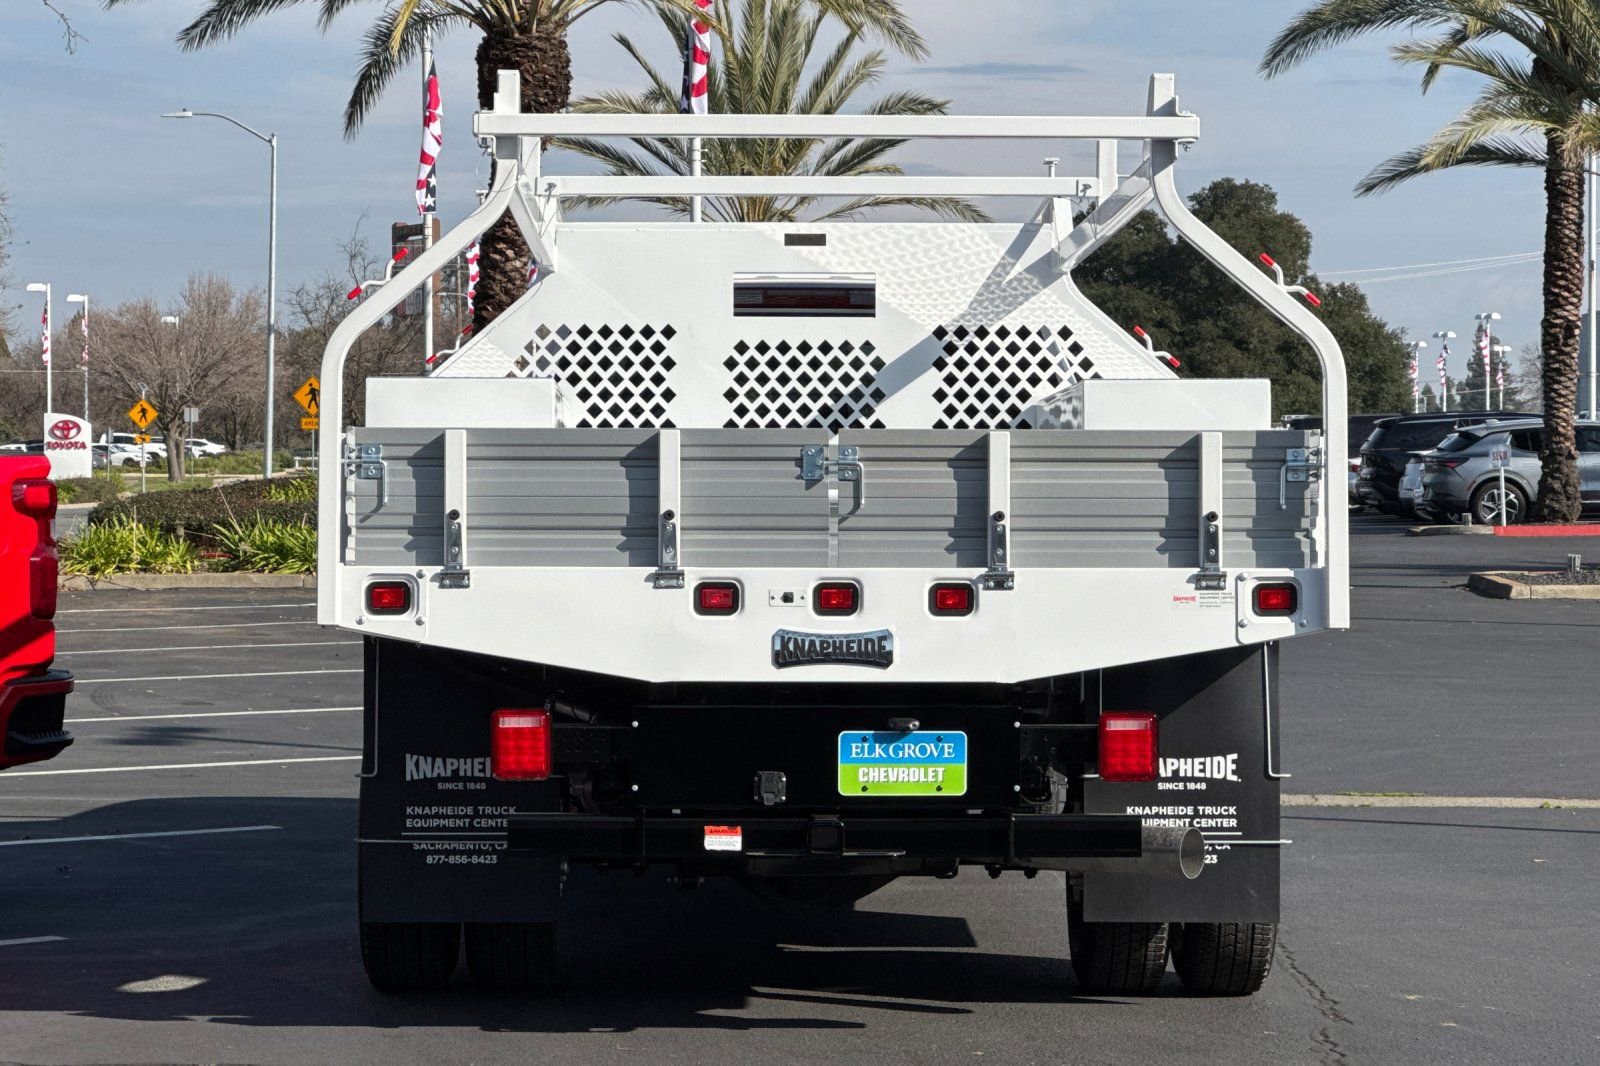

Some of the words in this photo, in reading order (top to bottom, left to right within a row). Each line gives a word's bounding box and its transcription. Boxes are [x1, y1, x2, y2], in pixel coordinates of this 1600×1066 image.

[303, 420, 320, 428] AHEA
[47, 441, 87, 450] TOYOTA
[779, 635, 889, 664] KNAPHEIDE
[850, 743, 887, 758] ELK
[889, 743, 956, 758] GROVE
[405, 753, 491, 781] KNAPHEI
[1159, 753, 1238, 782] APHEIDE
[858, 767, 945, 783] CHEVROLET
[437, 782, 464, 790] SINCE
[466, 782, 486, 790] 1848
[1157, 782, 1184, 790] SINCE
[1186, 782, 1207, 790] 1848
[406, 806, 474, 815] KNAPHEIDE
[477, 806, 517, 815] TRUCK
[1126, 806, 1194, 815] KNAPHEIDE
[1198, 806, 1237, 815] TRUCK
[406, 818, 471, 828] EQUIPMENT
[473, 818, 508, 828] CENTE
[1141, 818, 1191, 828] UIPMENT
[1193, 818, 1238, 828] CENTER
[426, 855, 497, 864] 877-856-8423
